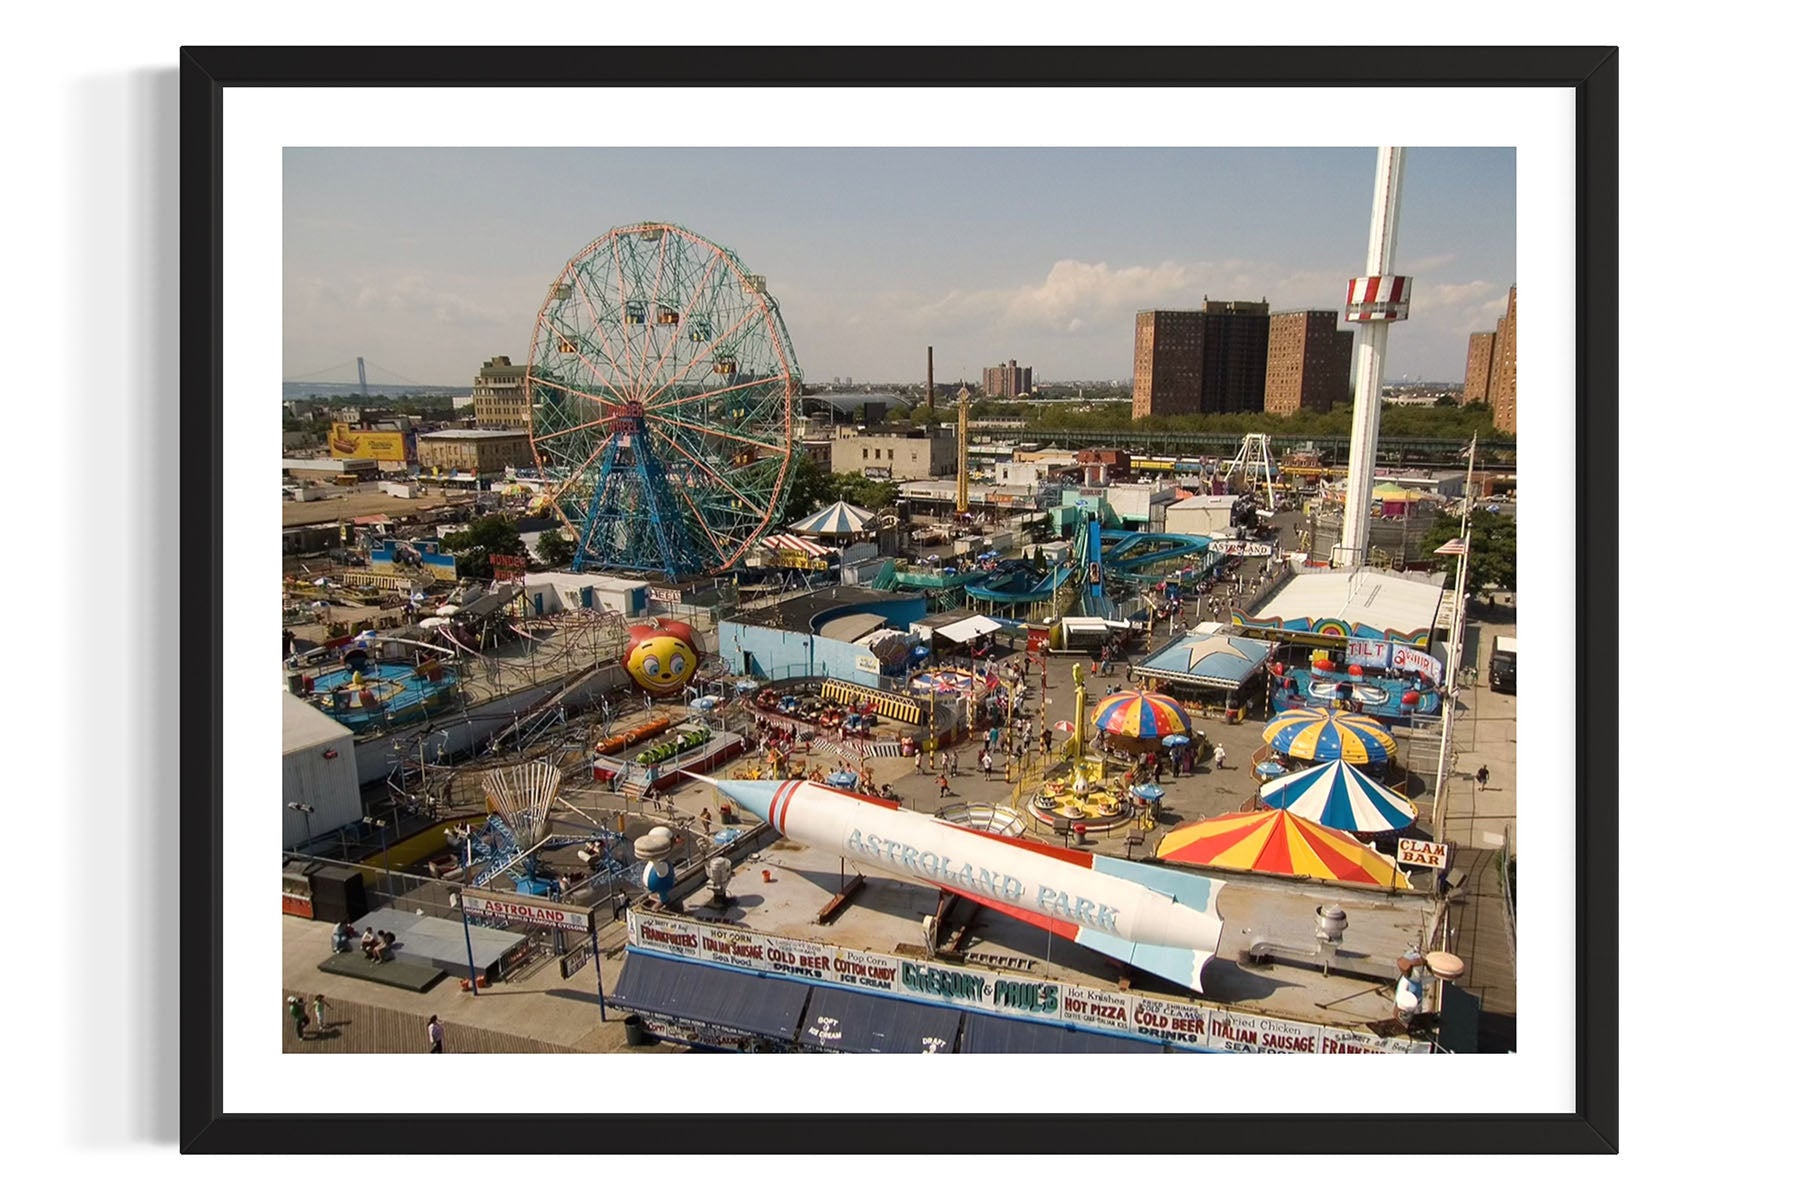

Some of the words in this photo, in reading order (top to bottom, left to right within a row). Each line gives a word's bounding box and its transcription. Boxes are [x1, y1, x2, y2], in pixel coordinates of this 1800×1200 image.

[1349, 643, 1384, 656] TILT
[1400, 839, 1445, 856] CLAM
[1403, 852, 1439, 865] BAR
[847, 827, 1026, 899] ASTROLAND
[1037, 884, 1120, 932] PARK
[485, 900, 565, 921] ASTROLAND
[529, 918, 556, 928] FAMOUS
[557, 923, 588, 932] CYCLONE
[711, 930, 727, 939] HOT
[729, 933, 752, 943] CORN
[702, 936, 730, 955] ITALIAN
[731, 941, 763, 960] SAUSAGE
[730, 956, 752, 967] Food
[767, 948, 796, 965] COLD
[800, 955, 830, 971] BEER
[847, 952, 864, 963] Pop
[866, 956, 887, 966] Corn
[773, 963, 822, 978] DRINKS
[834, 957, 866, 976] COTTON
[868, 966, 896, 981] CANDY
[840, 974, 856, 984] ICE
[859, 977, 891, 990] CREAM
[902, 962, 984, 1002] GREGORY
[983, 984, 993, 996] &
[1068, 988, 1083, 998] Hot
[1087, 991, 1126, 1006] Knishes
[1065, 997, 1088, 1014] HOT
[1091, 1004, 1127, 1022] PIZZA
[1134, 1010, 1168, 1028] COLD
[1172, 1018, 1205, 1035] BEER
[1260, 1020, 1301, 1035] Chicken
[922, 1038, 946, 1048] DRAFT
[1138, 1026, 1197, 1043] DRINKS
[1212, 1019, 1257, 1044] ITALIAN
[1262, 1033, 1315, 1053] SAUSAGE
[1225, 1041, 1251, 1053] SEA
